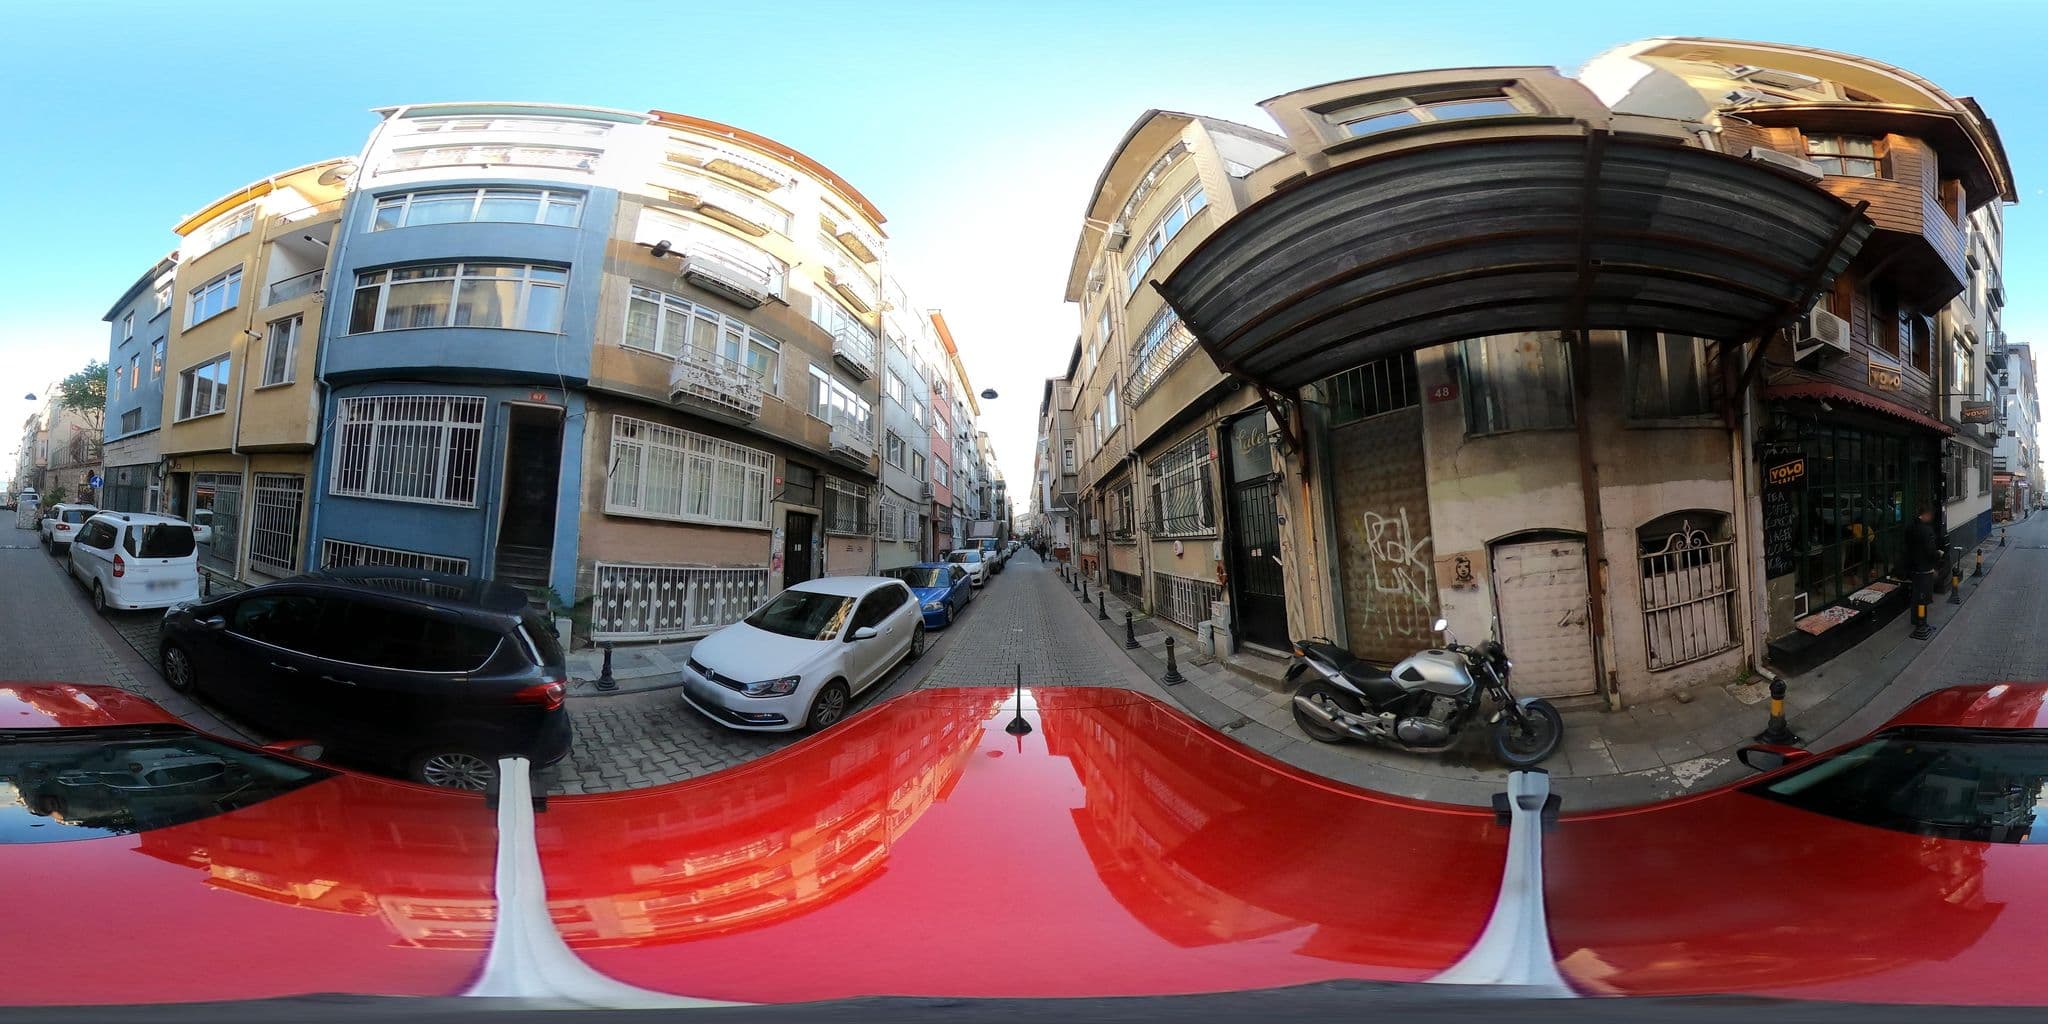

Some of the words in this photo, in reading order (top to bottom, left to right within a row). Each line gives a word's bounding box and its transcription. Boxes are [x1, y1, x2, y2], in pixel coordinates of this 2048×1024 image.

[1870, 370, 1900, 386] YOLO
[1435, 387, 1450, 398] 48
[1771, 463, 1802, 479] YOLO
